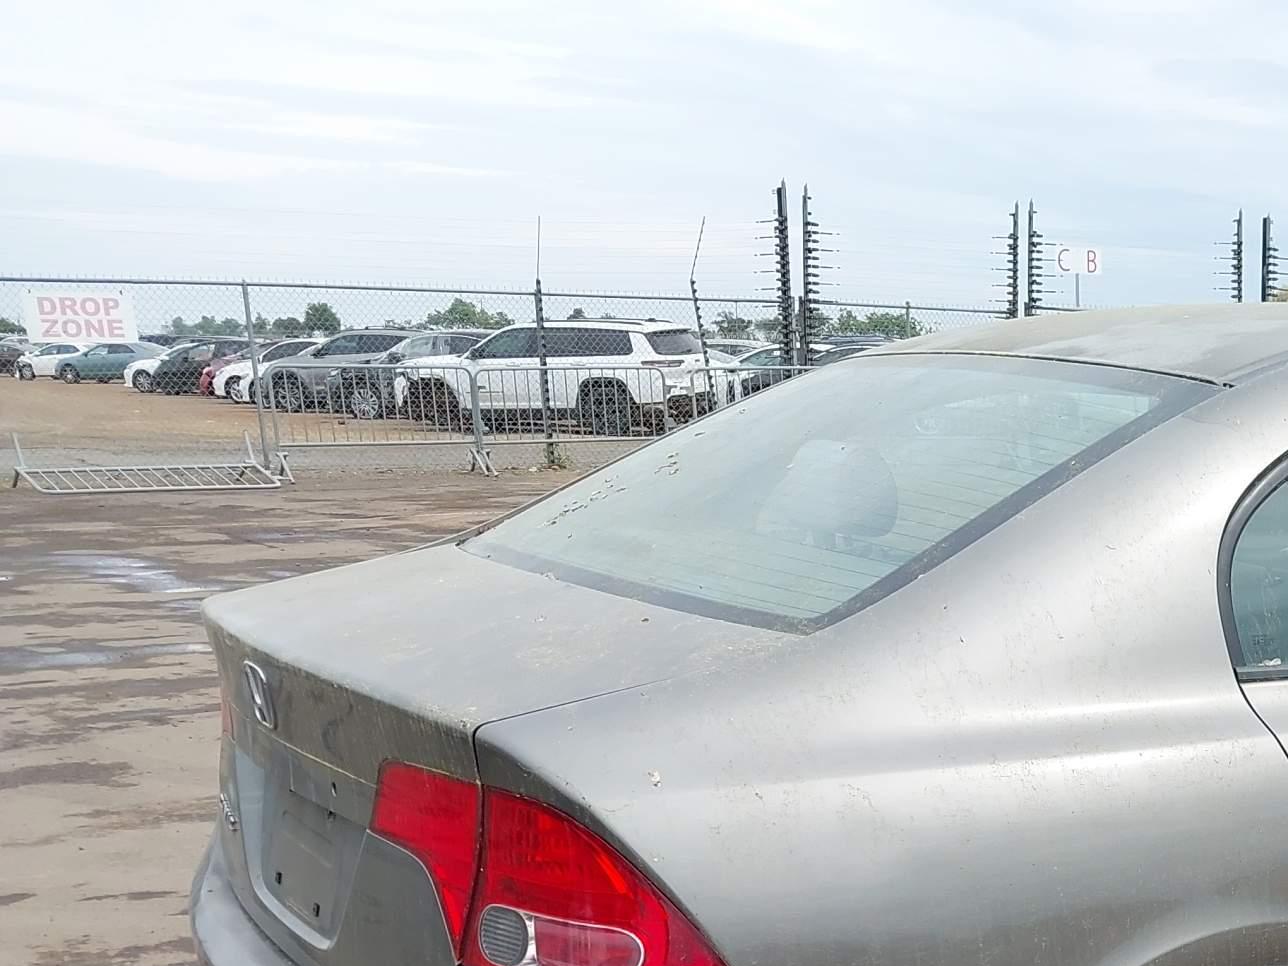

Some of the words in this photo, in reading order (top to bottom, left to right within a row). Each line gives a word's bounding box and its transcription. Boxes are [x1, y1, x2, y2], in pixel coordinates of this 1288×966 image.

[1086, 249, 1097, 273] B
[36, 296, 120, 317] DROP
[40, 318, 126, 338] ZONE
